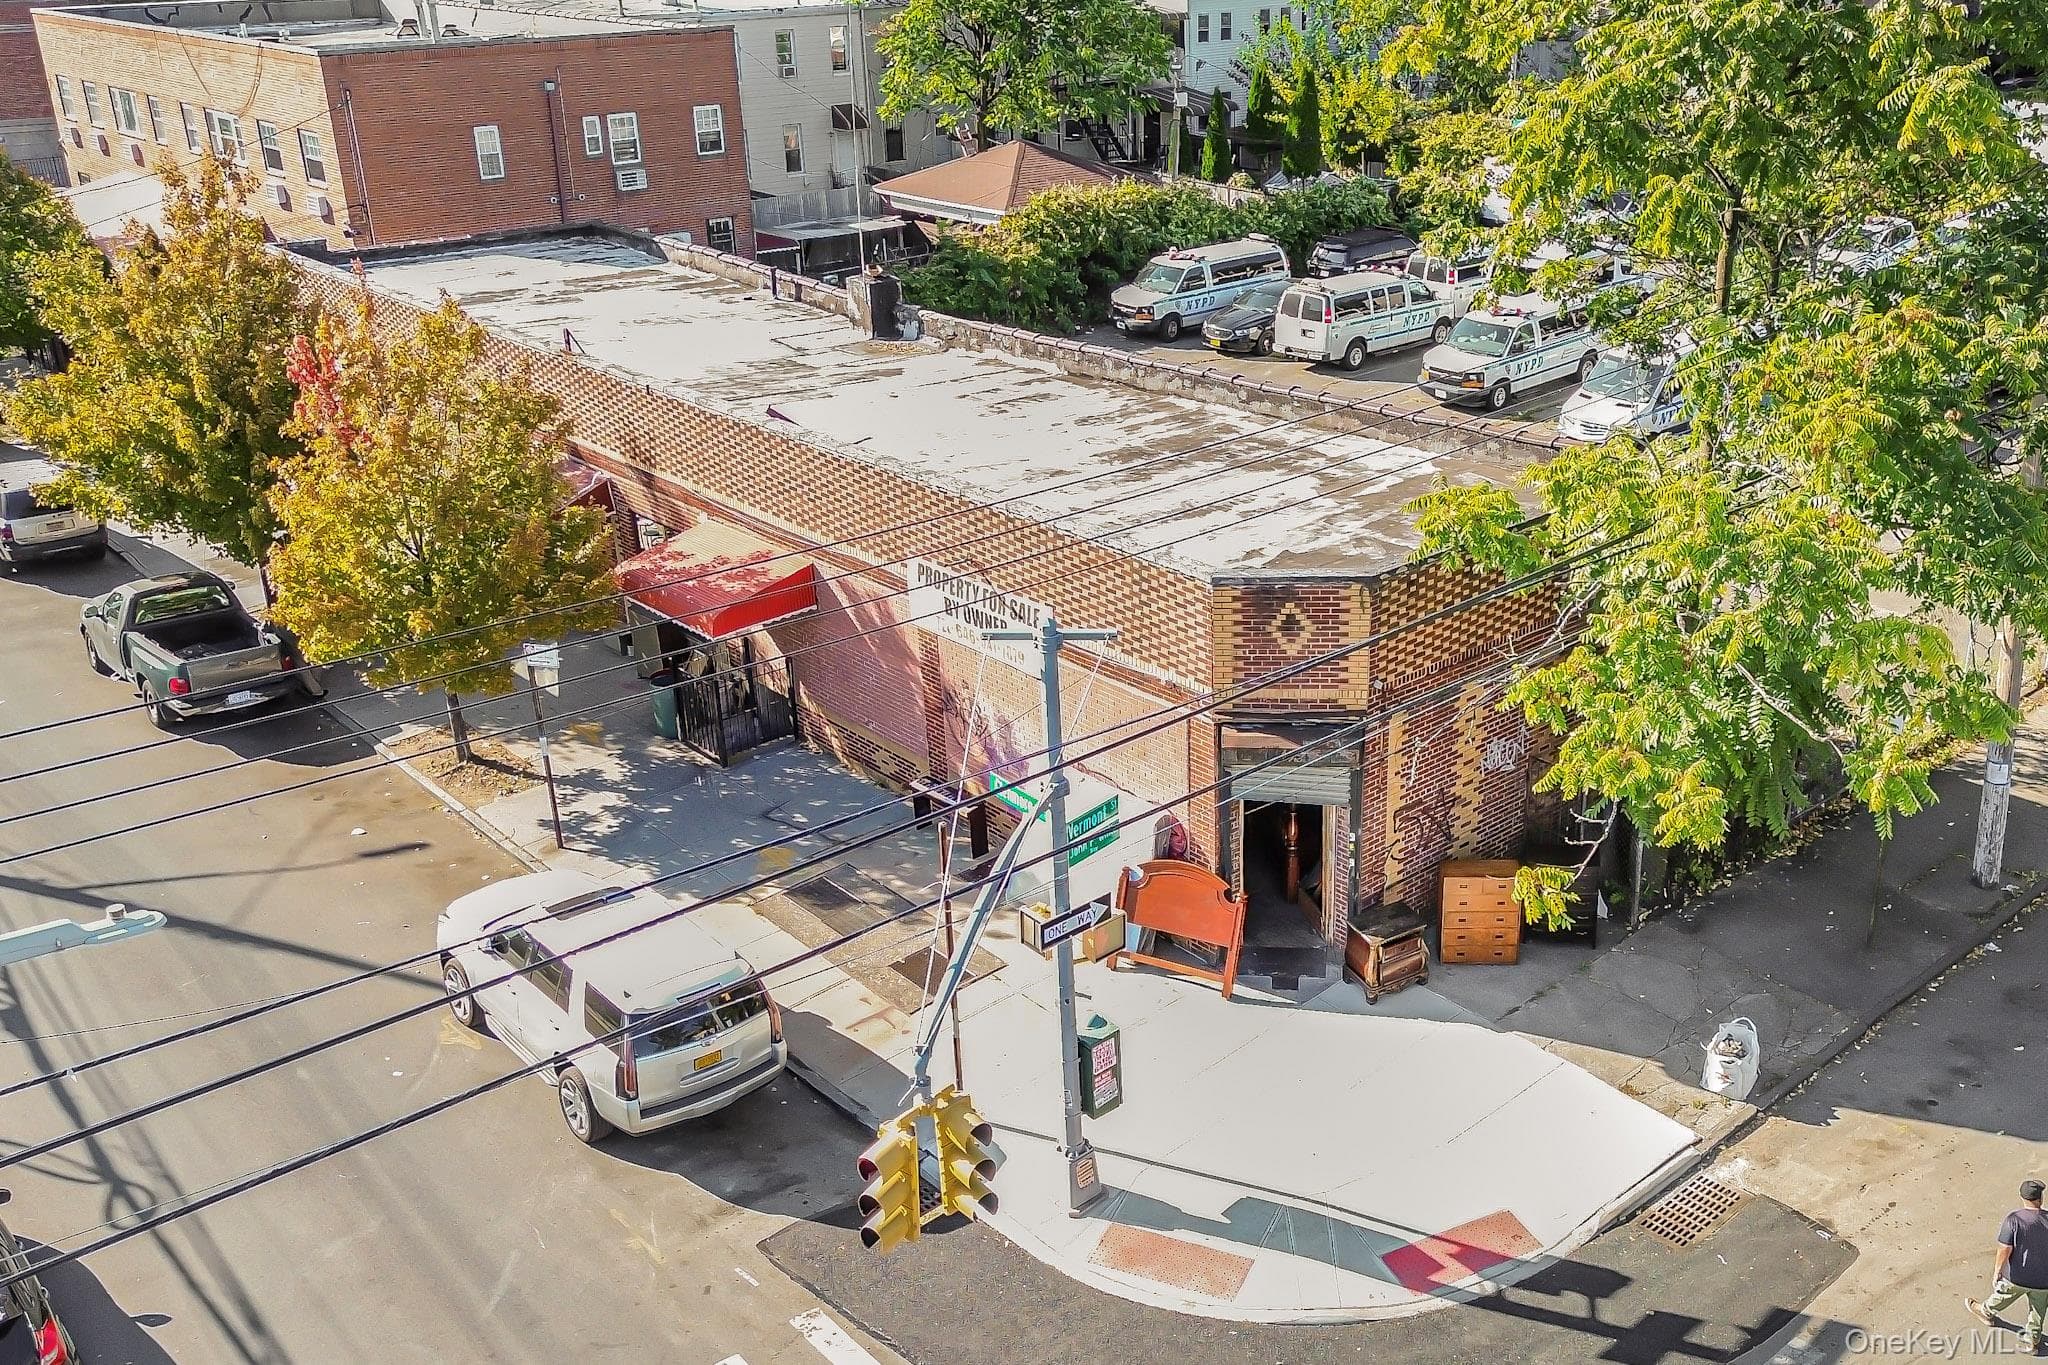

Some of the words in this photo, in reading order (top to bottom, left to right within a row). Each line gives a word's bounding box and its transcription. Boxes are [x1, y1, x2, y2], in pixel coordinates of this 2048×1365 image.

[1185, 296, 1215, 311] NYPD
[1402, 311, 1430, 328] NYPD
[1515, 356, 1544, 376] NYPD
[917, 562, 979, 602] PROPERTY
[982, 587, 1007, 617] FOR
[1009, 598, 1040, 629] SALE
[943, 596, 960, 619] BY
[1067, 805, 1107, 841] Vermont
[1048, 921, 1068, 939] ONE
[1076, 906, 1098, 925] WAY
